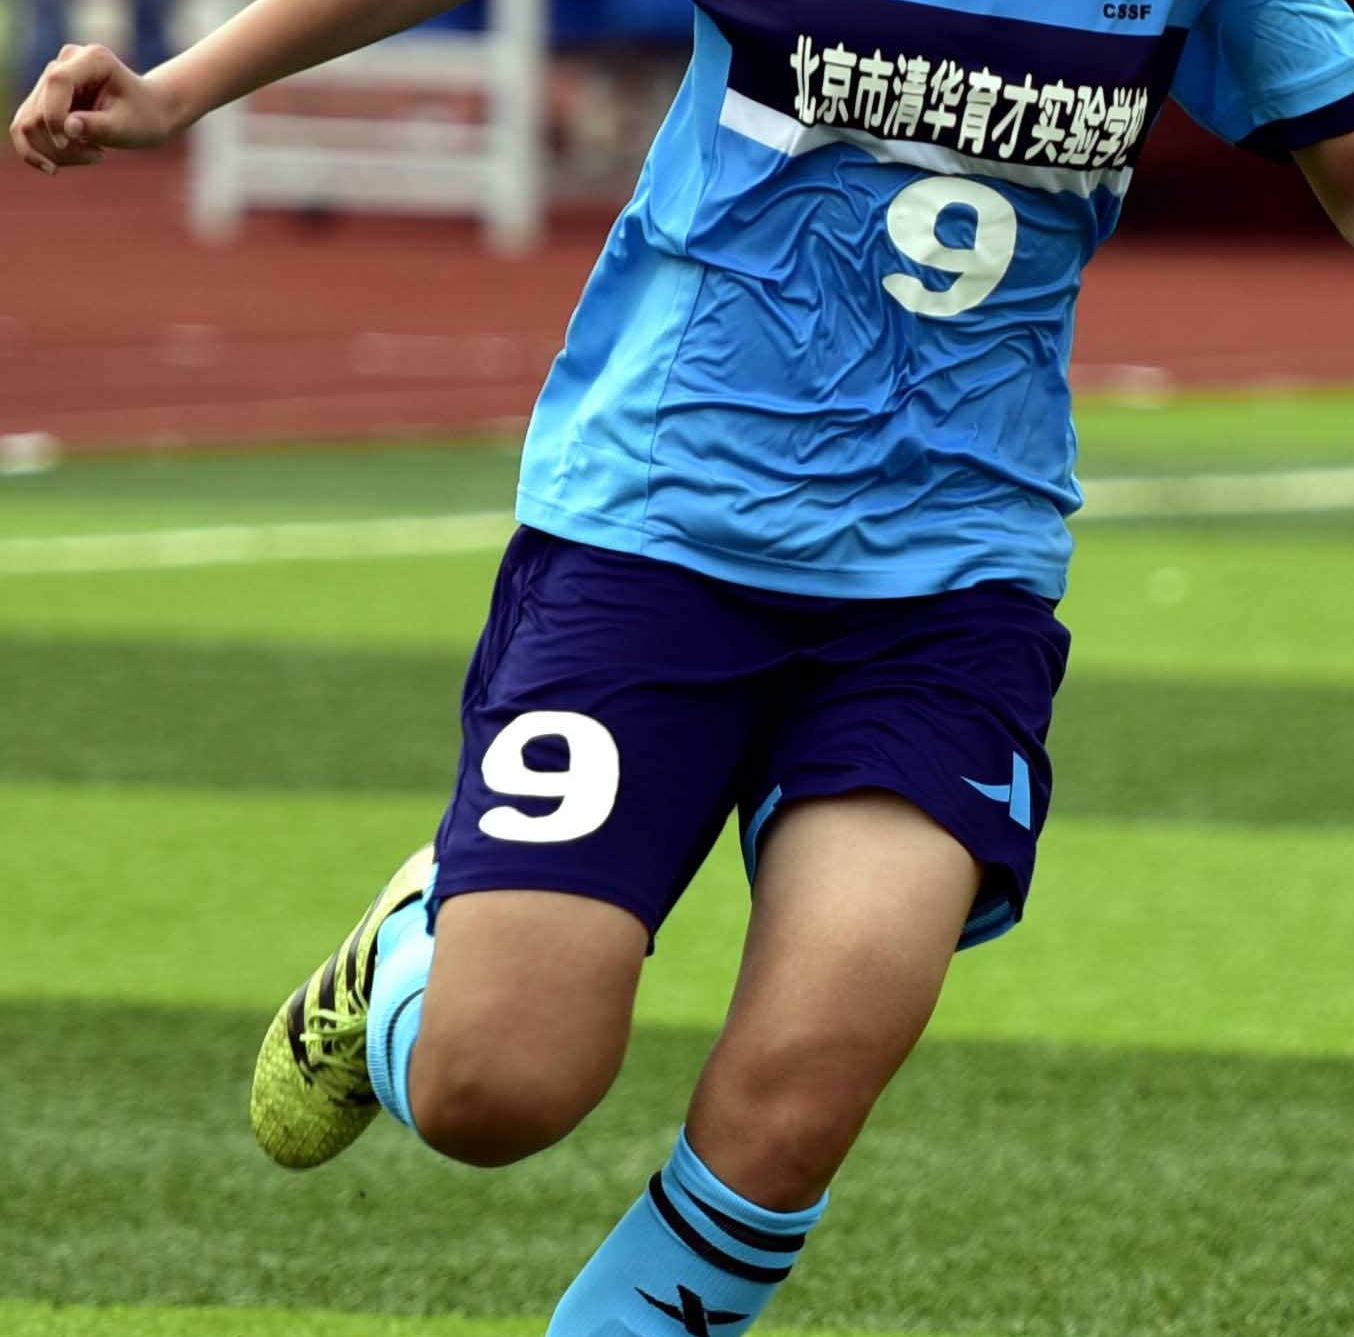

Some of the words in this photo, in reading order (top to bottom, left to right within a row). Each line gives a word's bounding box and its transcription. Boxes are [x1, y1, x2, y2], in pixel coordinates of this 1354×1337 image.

[1103, 3, 1152, 20] CSSF
[882, 175, 1018, 317] 9
[478, 710, 620, 842] 9
